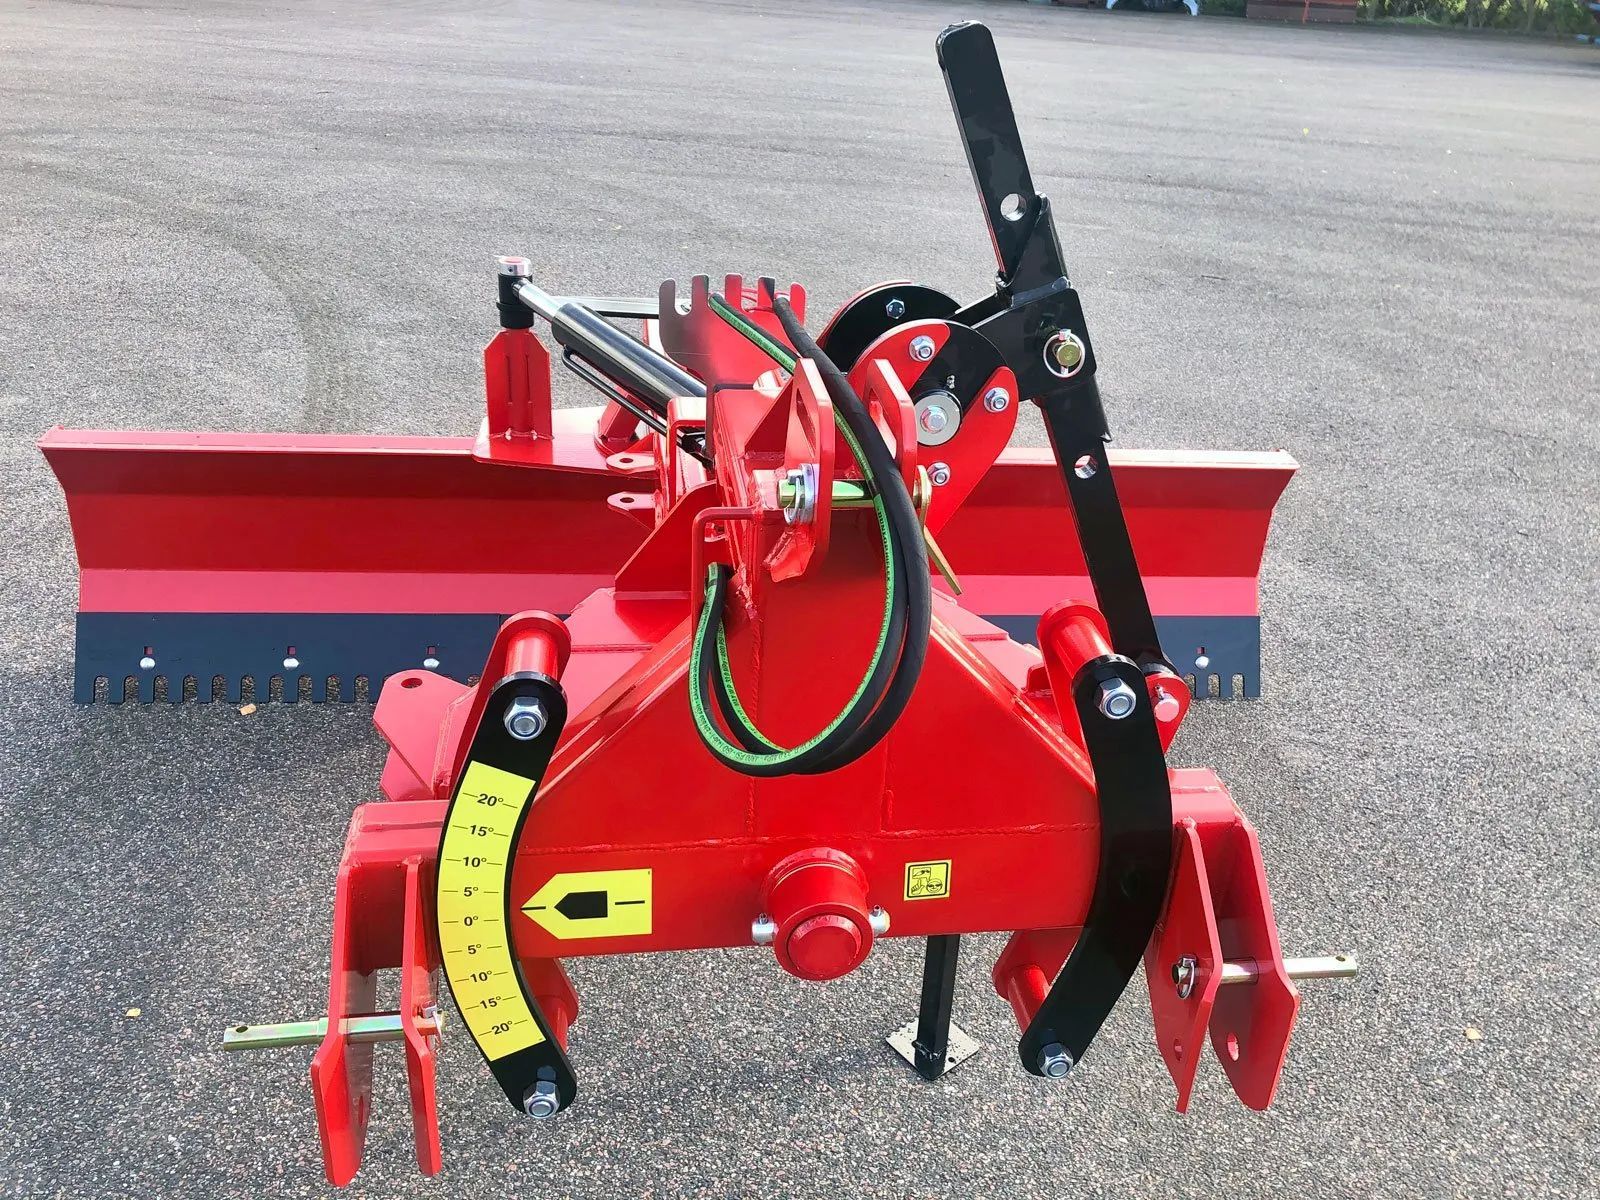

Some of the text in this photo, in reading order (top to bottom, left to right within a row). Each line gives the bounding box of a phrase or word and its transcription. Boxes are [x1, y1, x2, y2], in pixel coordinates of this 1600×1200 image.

[477, 793, 504, 806] 20°
[470, 824, 494, 837] 15°
[462, 856, 487, 868] 10°
[463, 886, 479, 897] 5°
[463, 915, 479, 927] 0°
[467, 943, 482, 955] 5°
[470, 970, 493, 983] 10°
[479, 995, 502, 1010] 15°
[491, 1020, 513, 1035] 20°
